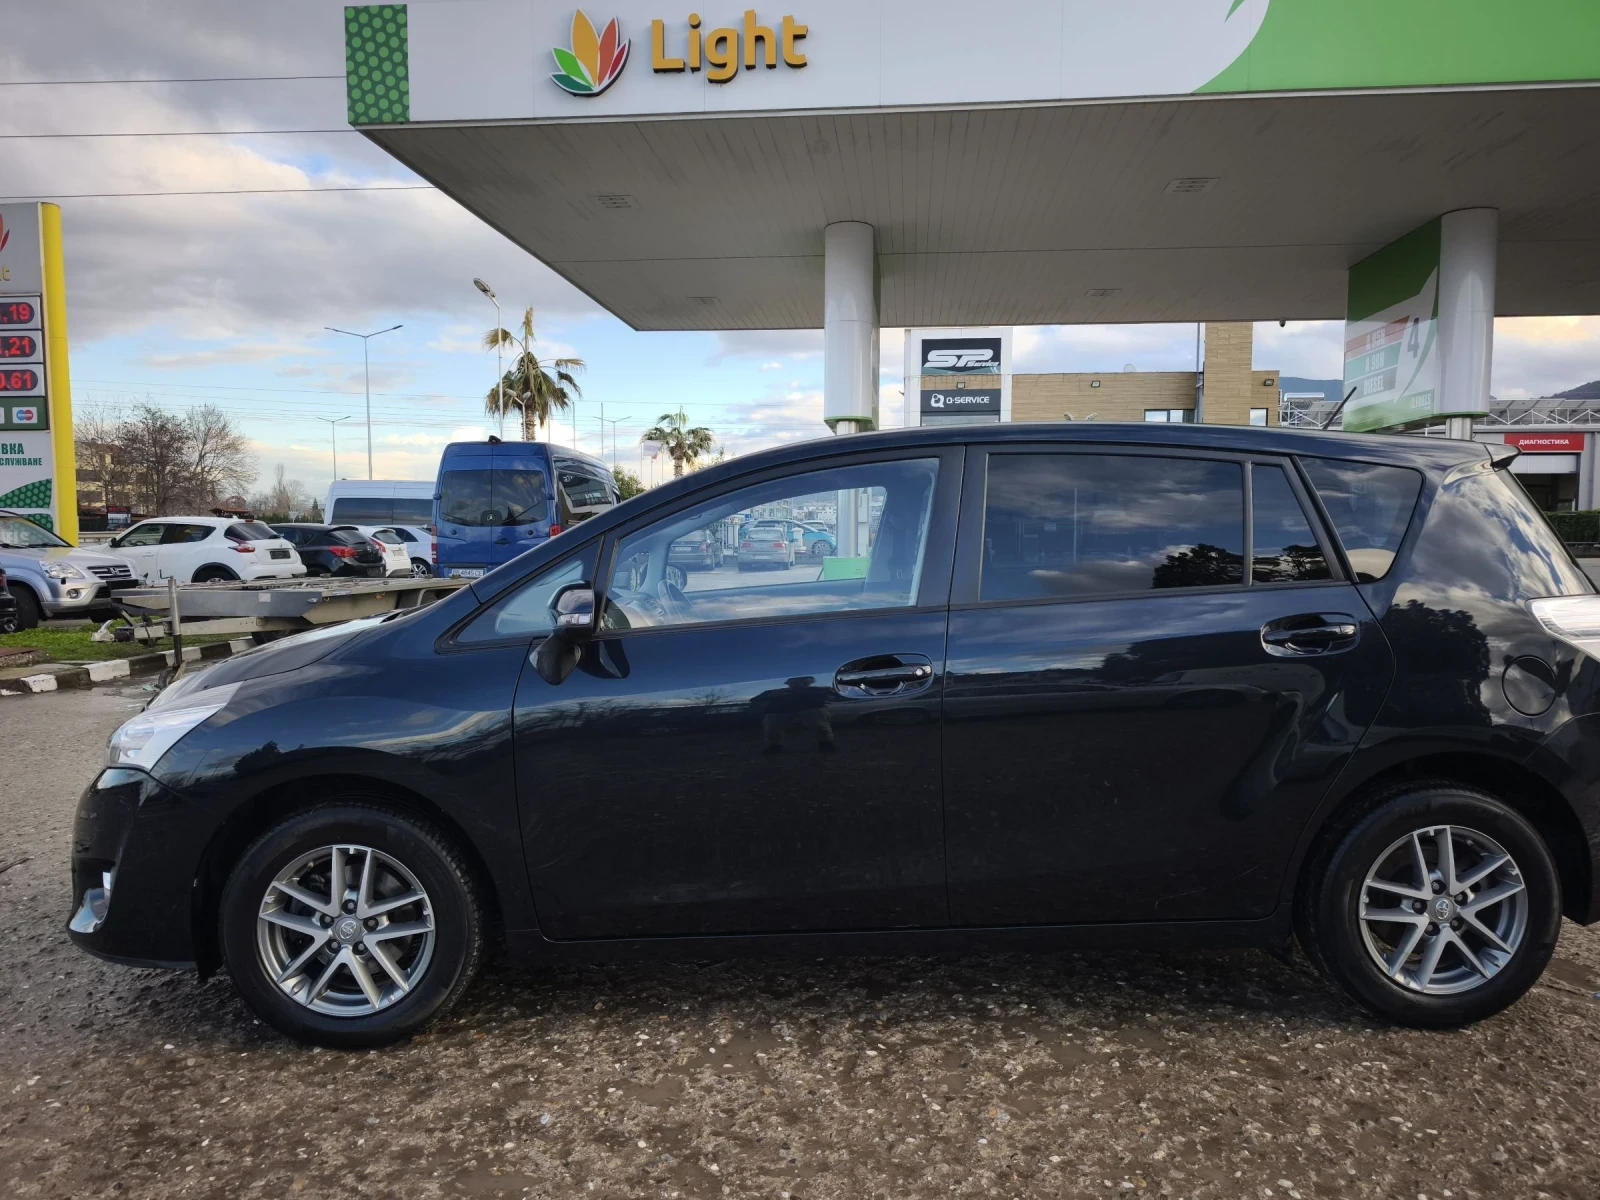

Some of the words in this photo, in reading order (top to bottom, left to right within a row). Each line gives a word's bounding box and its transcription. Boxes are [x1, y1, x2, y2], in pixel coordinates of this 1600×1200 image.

[651, 9, 808, 84] Light
[1407, 317, 1420, 358] 4
[923, 348, 994, 368] SP
[1363, 374, 1384, 396] DIESEL
